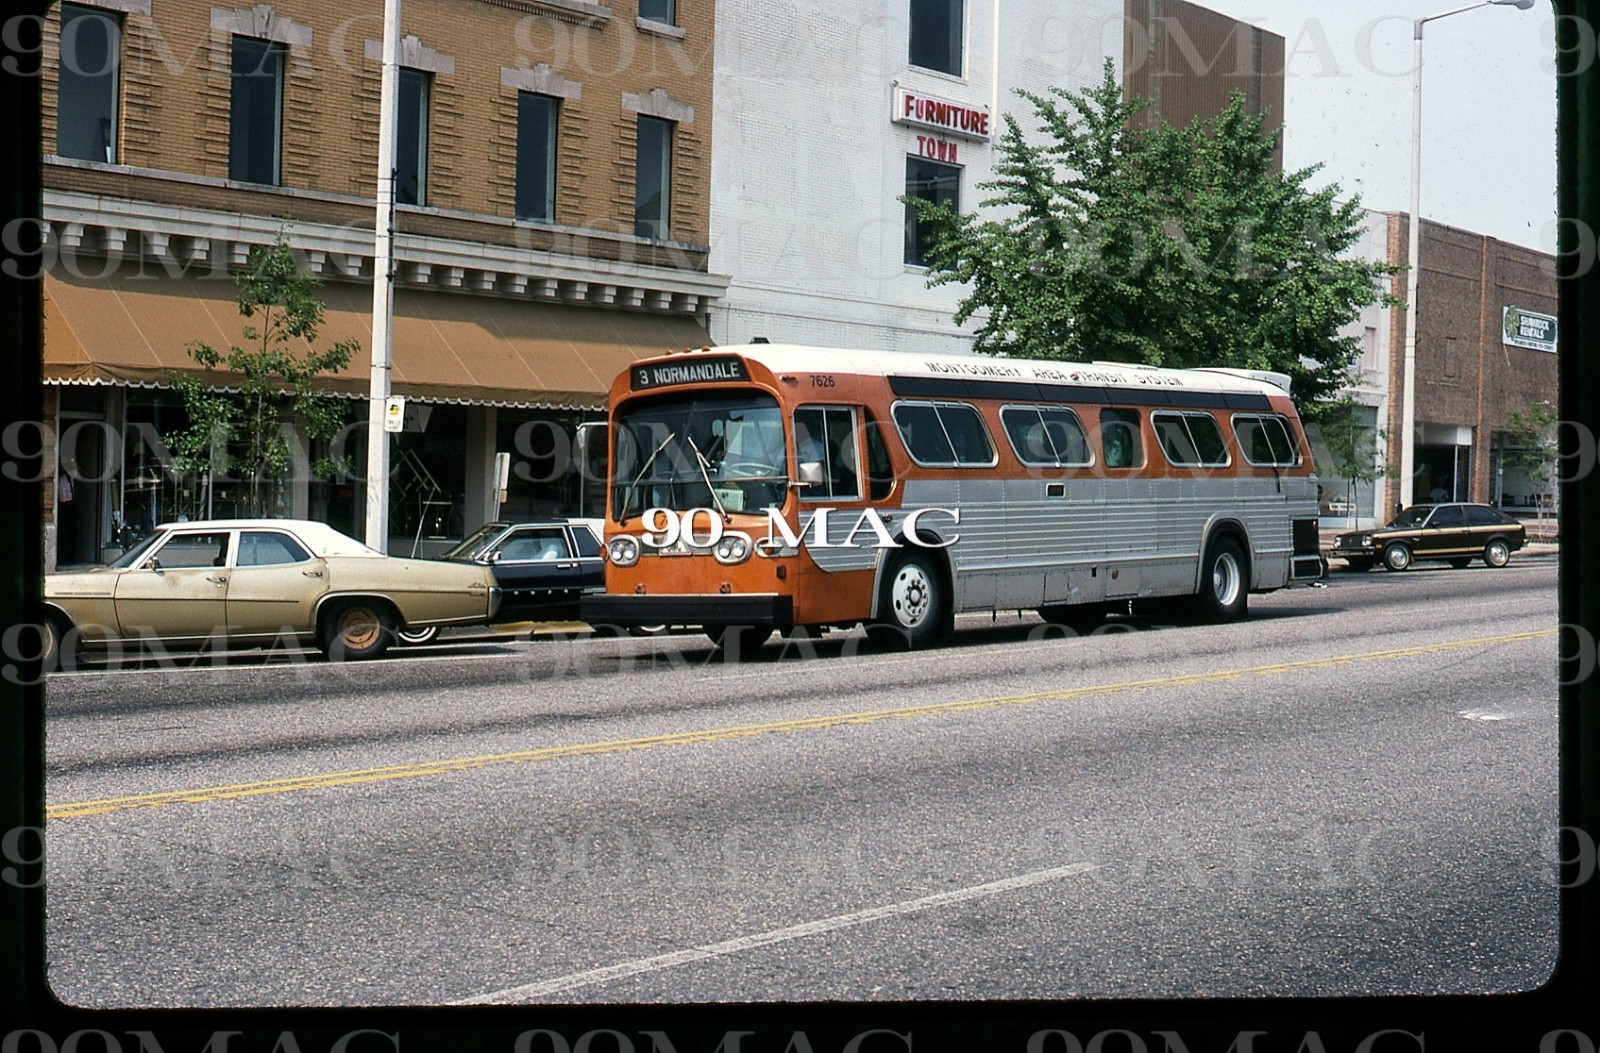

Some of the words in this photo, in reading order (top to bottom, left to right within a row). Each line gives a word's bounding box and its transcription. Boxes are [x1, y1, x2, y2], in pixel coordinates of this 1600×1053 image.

[905, 95, 989, 135] FURNITURE
[917, 135, 957, 163] TOWN
[639, 370, 649, 385] 3
[653, 362, 740, 384] NORMANDALE
[809, 375, 836, 388] 7626
[924, 361, 1022, 378] MONTGOMERY
[1031, 368, 1067, 381] AREA
[1078, 371, 1127, 383] TRANSIT
[1134, 374, 1183, 386] SYSTEM
